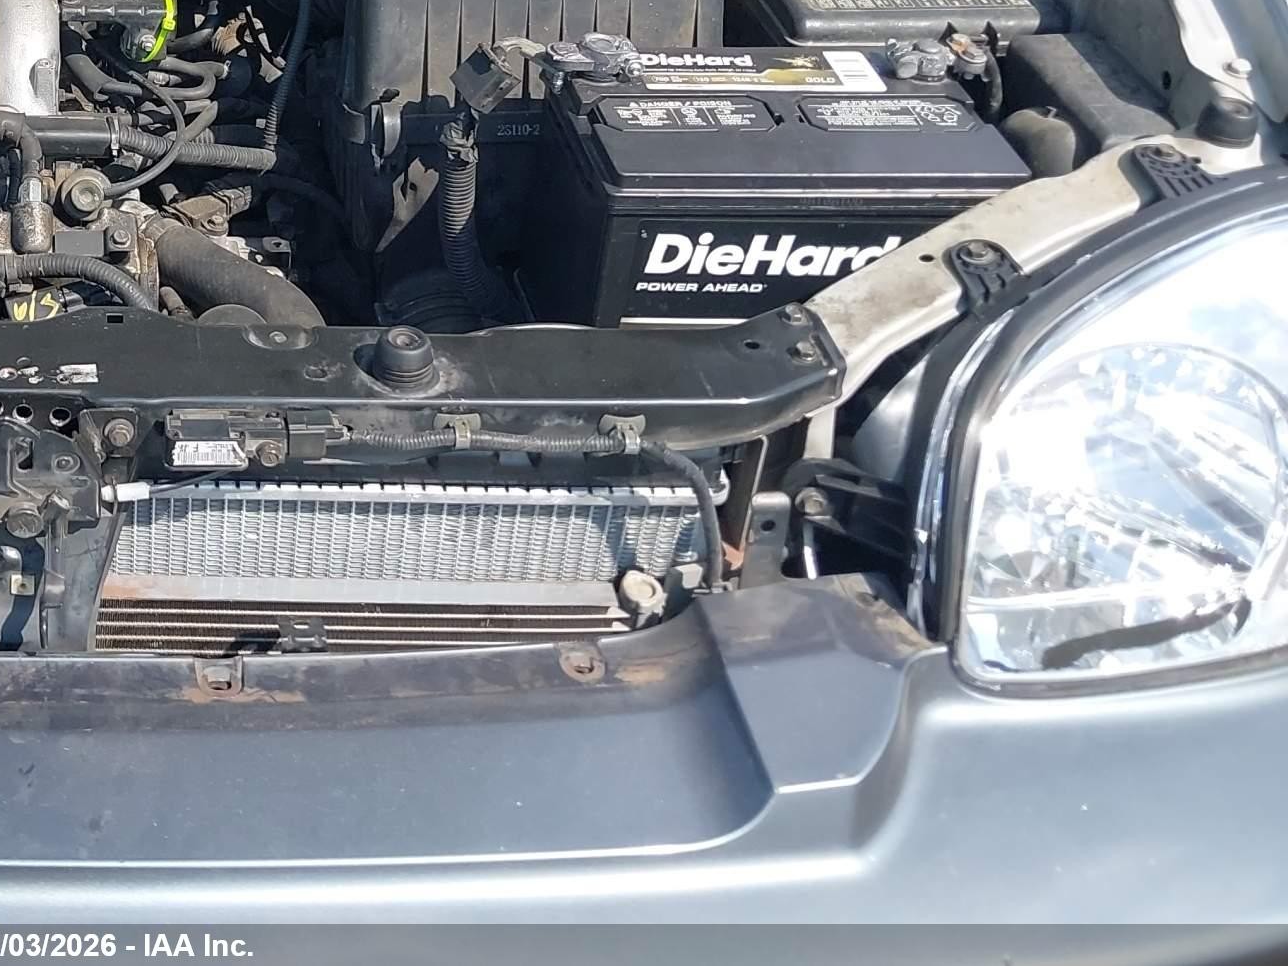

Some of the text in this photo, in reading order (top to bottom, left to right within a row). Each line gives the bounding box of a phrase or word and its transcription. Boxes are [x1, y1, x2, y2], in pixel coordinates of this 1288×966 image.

[641, 52, 756, 67] DieHard
[805, 76, 835, 84] GOLD
[644, 232, 902, 276] DieHard
[636, 282, 698, 293] POWER
